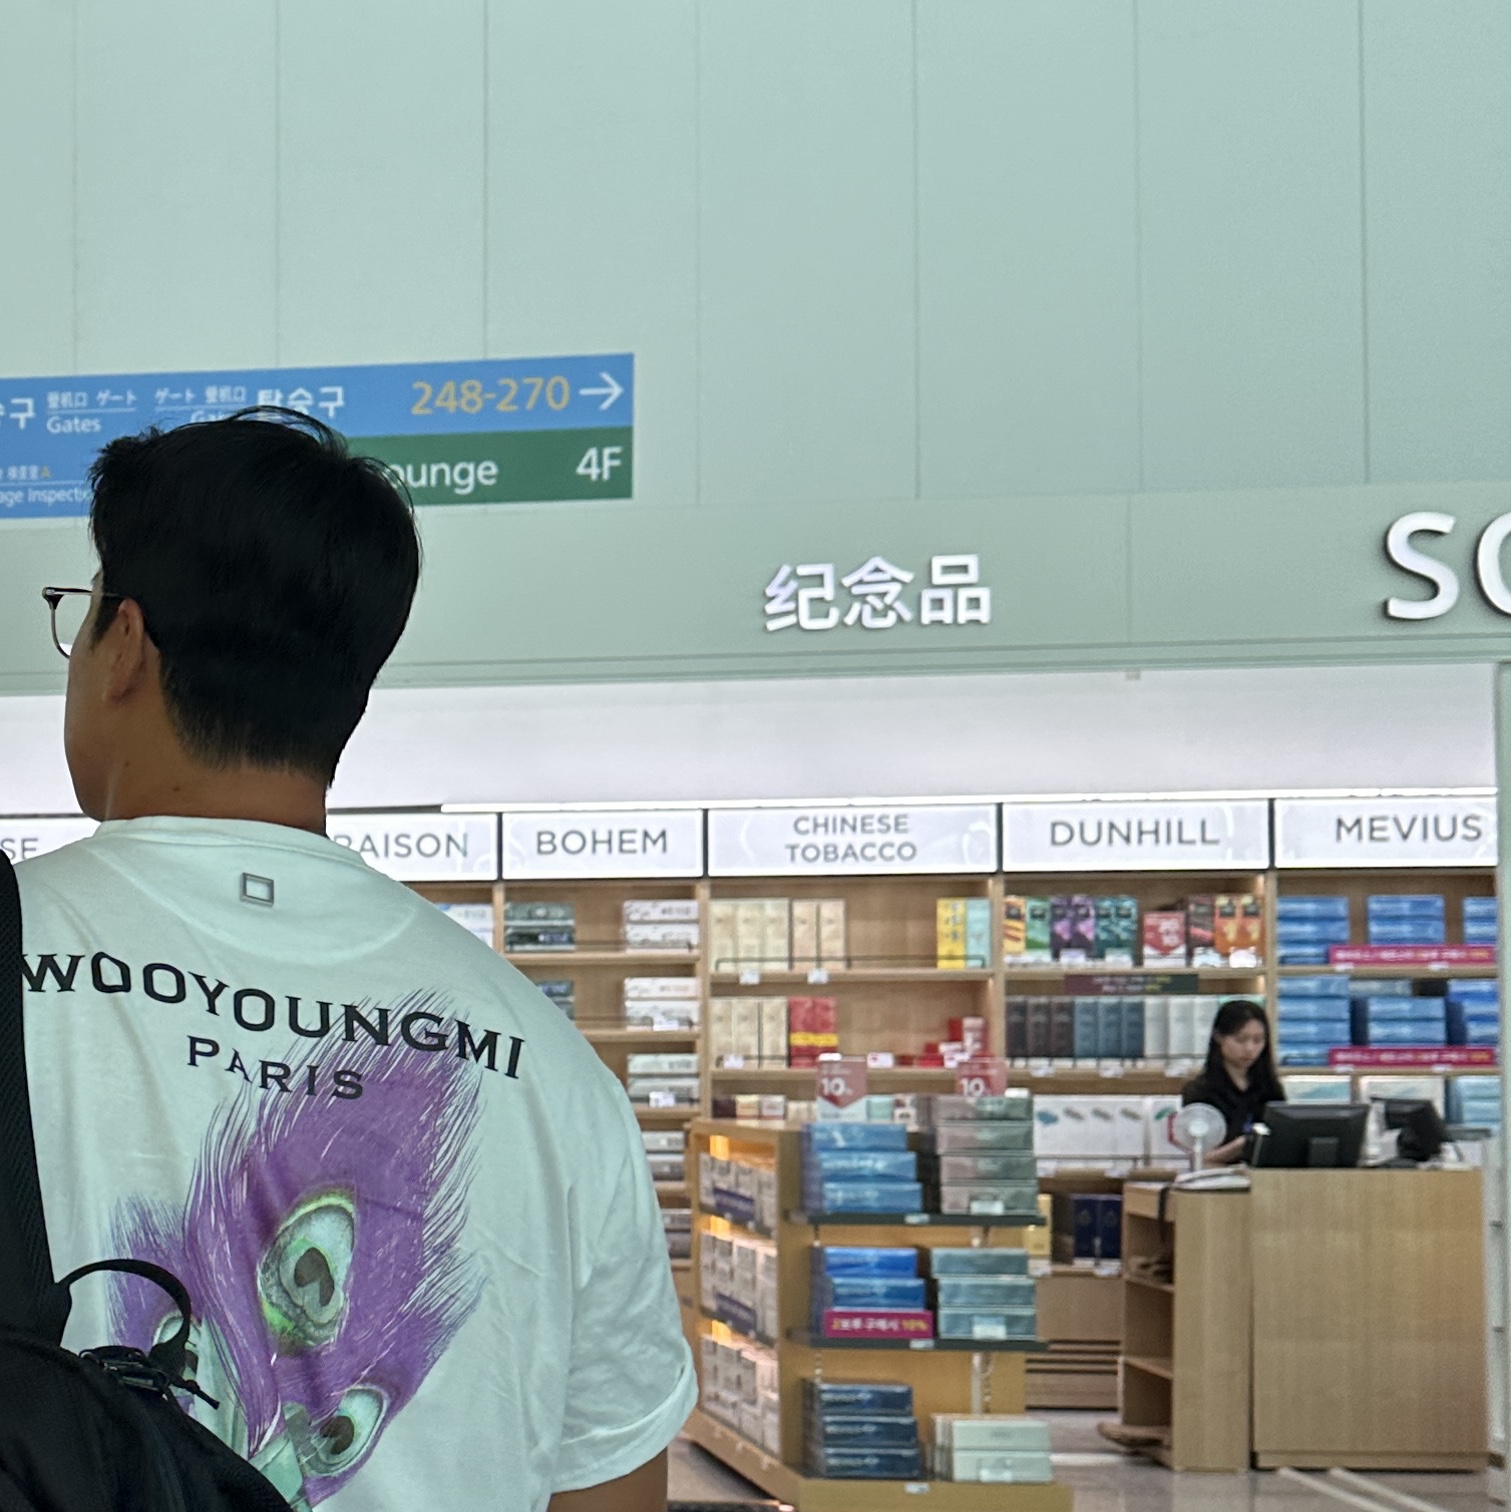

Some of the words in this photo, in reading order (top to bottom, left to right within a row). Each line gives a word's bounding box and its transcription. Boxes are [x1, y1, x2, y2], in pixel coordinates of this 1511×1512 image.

[410, 375, 571, 416] 248-270
[46, 415, 102, 435] Gates
[385, 459, 499, 496] ounge
[575, 446, 624, 482] 4F
[763, 553, 993, 633] 纪念品
[792, 813, 909, 836] CHINESE
[1049, 818, 1222, 847] DUNHILL
[1334, 814, 1484, 843] MEVIUS
[536, 828, 669, 856] BOHEM
[784, 841, 918, 864] TOBACCO
[21, 950, 526, 1080] WOOYOUNGMI
[187, 1035, 365, 1101] PARIS
